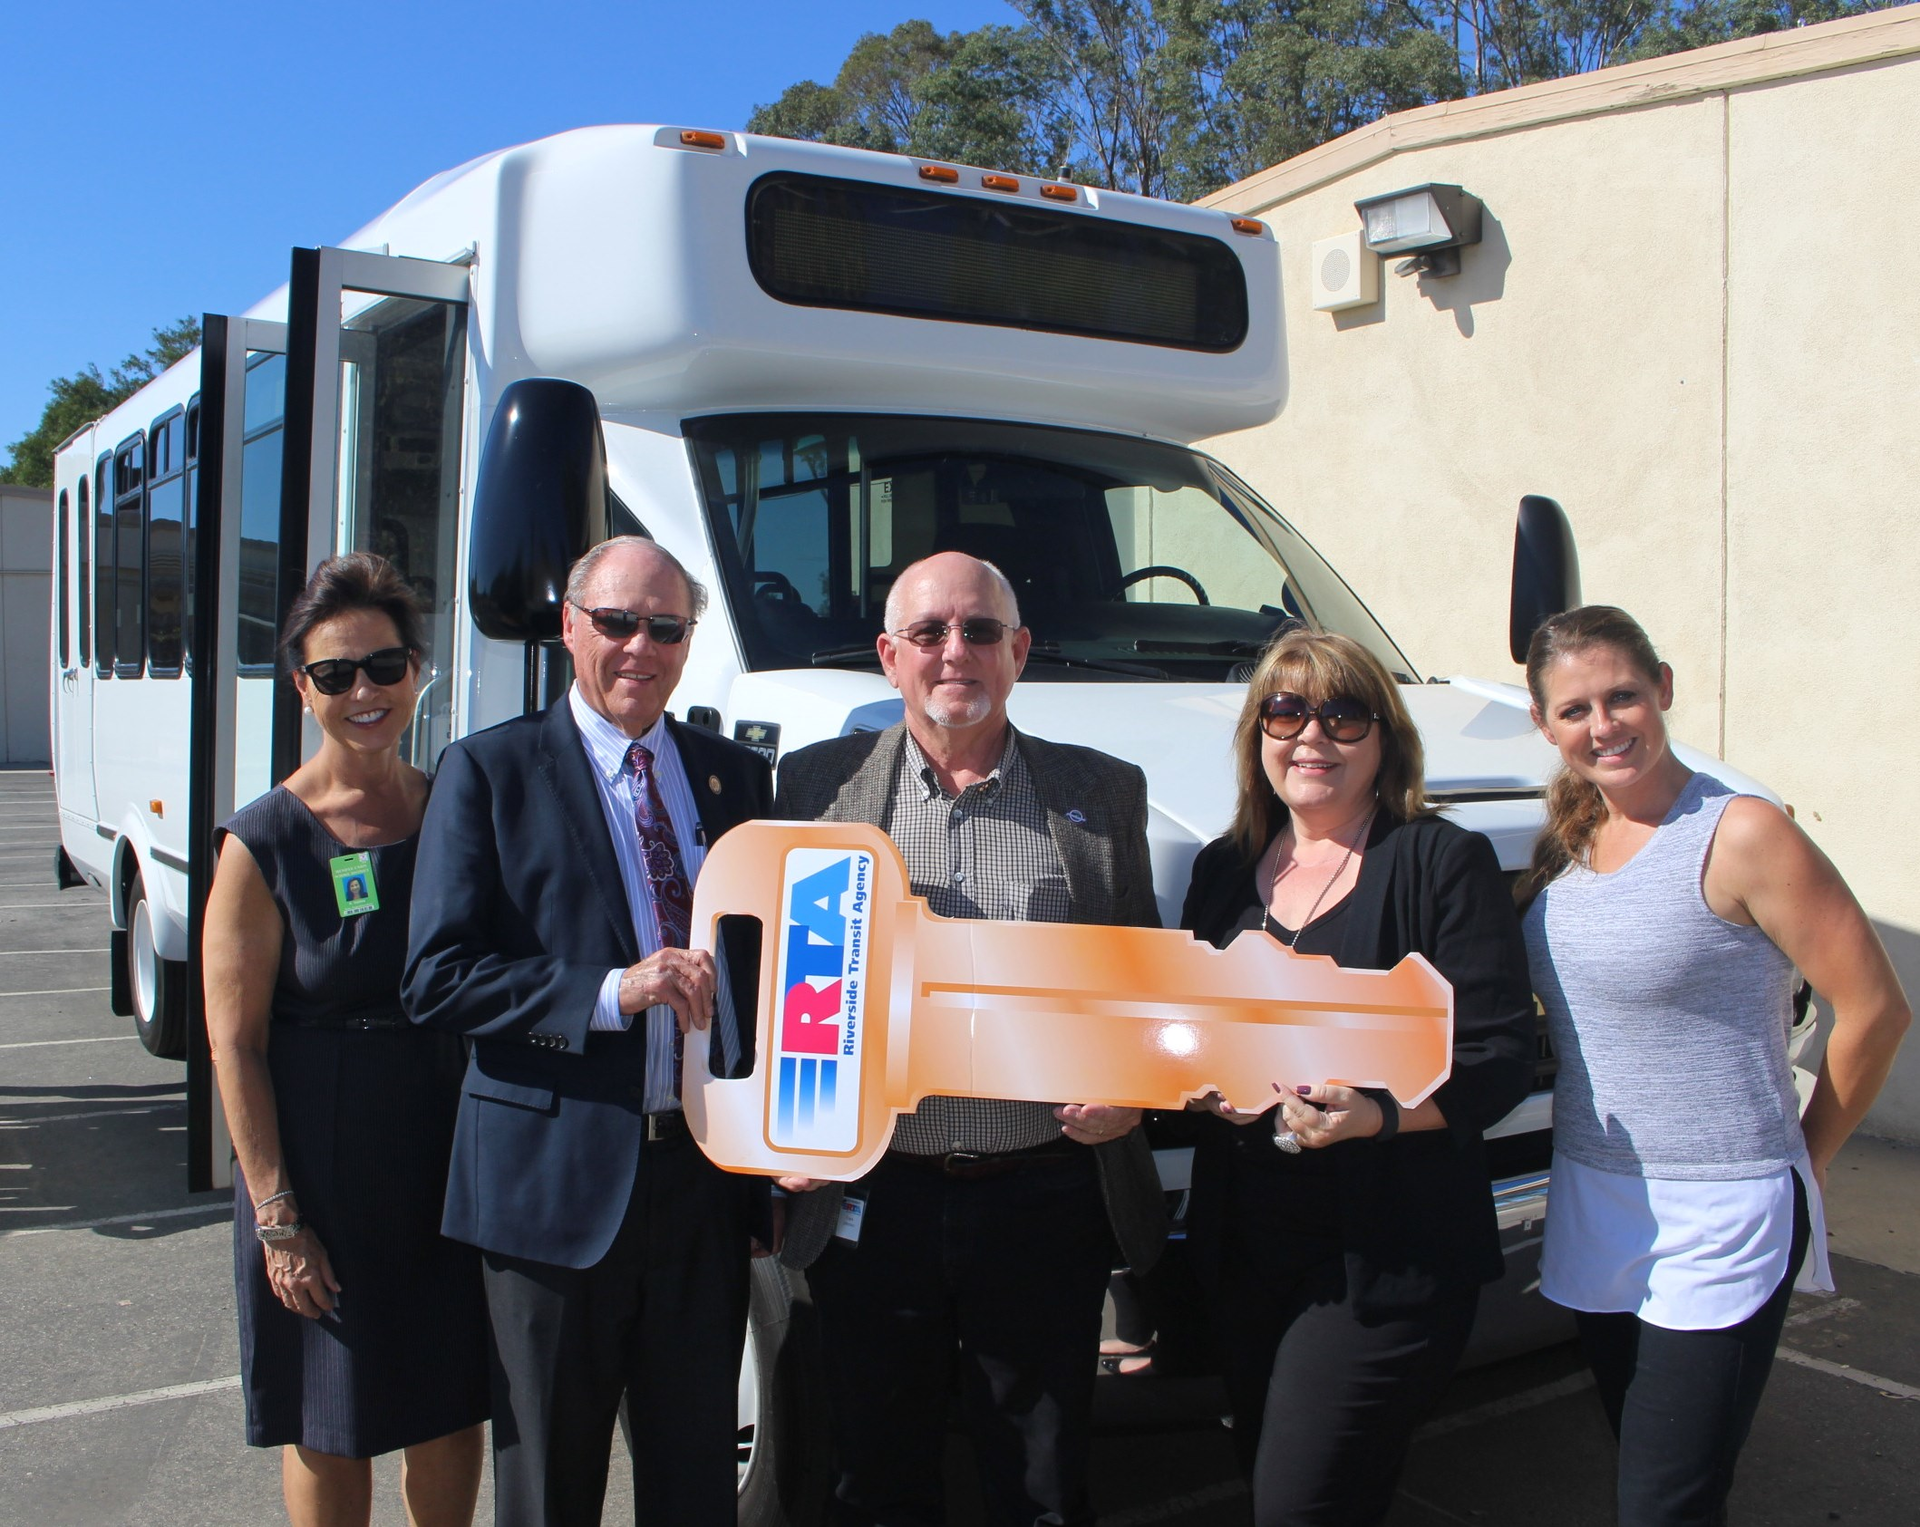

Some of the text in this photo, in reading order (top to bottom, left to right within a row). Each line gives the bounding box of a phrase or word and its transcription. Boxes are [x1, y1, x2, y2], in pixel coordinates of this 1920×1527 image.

[781, 856, 851, 1055] RTA
[843, 855, 870, 1056] Riverside Transit Agency
